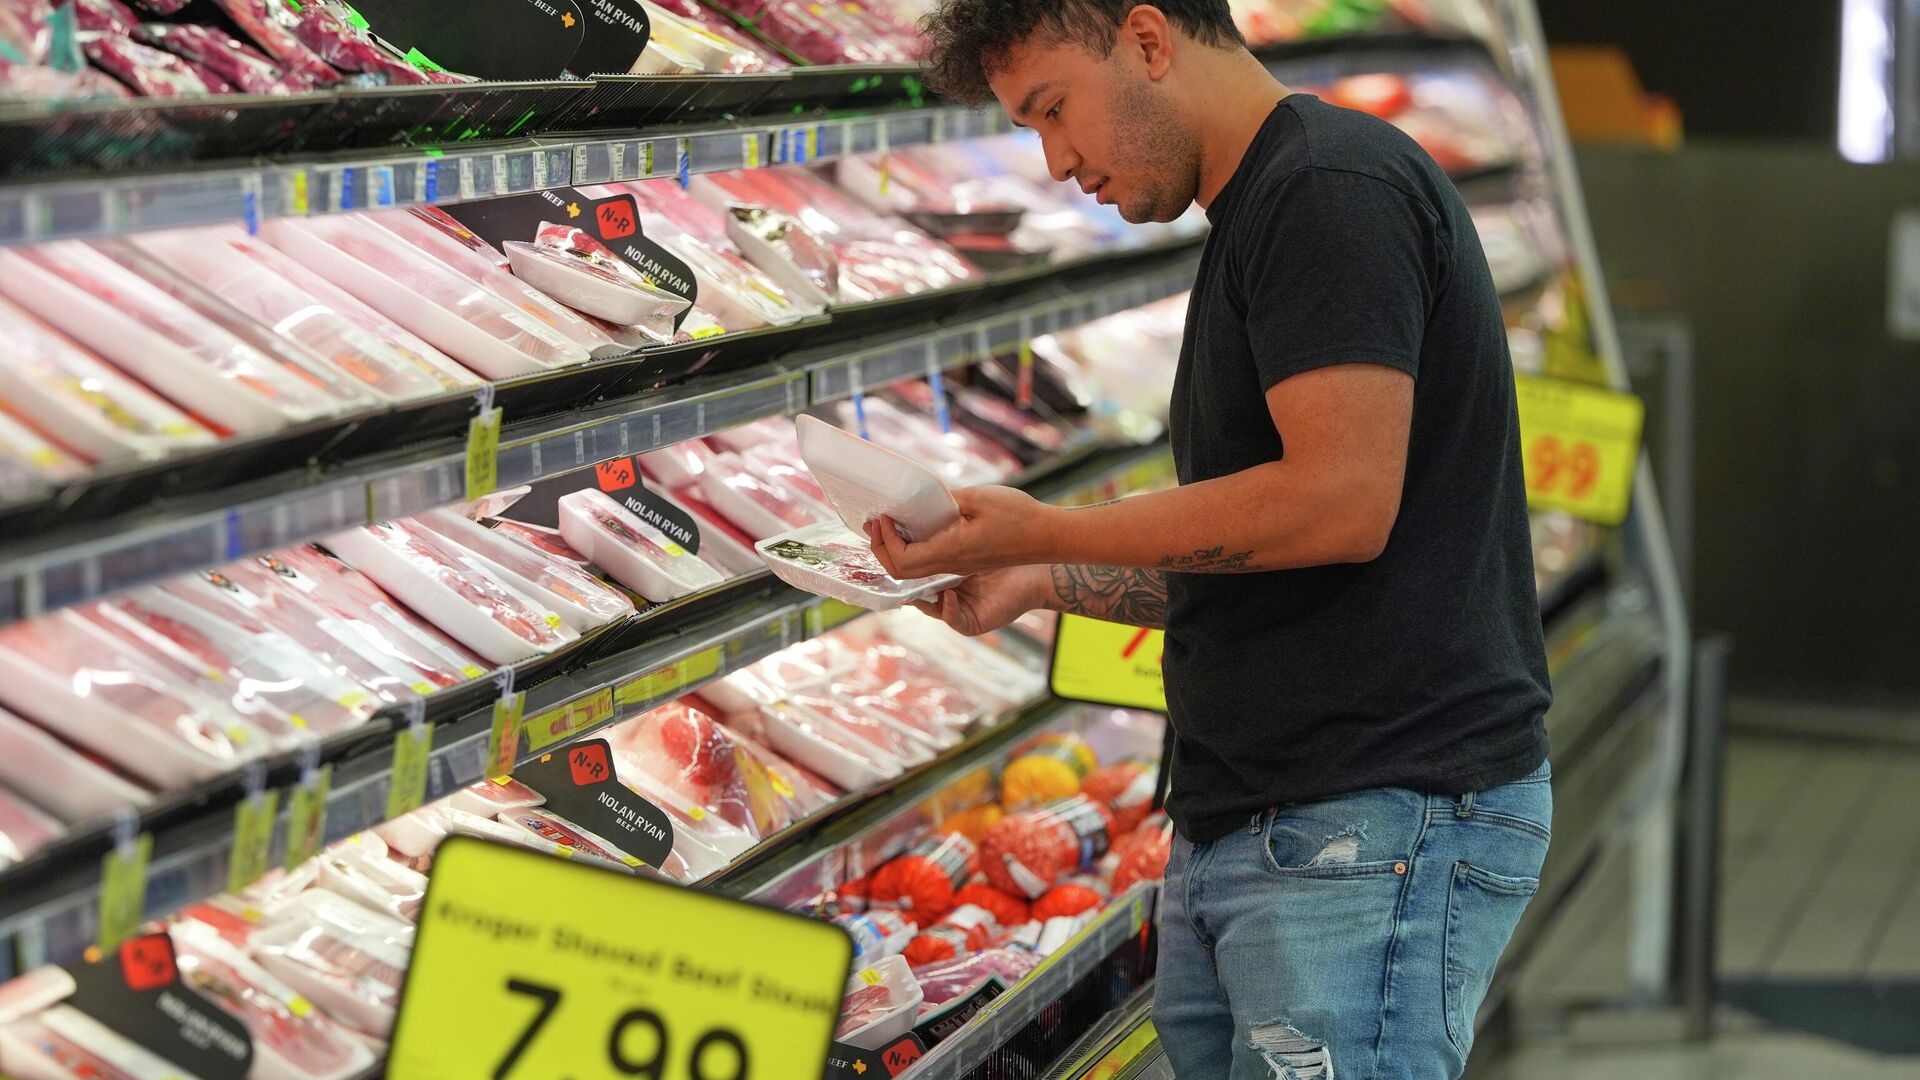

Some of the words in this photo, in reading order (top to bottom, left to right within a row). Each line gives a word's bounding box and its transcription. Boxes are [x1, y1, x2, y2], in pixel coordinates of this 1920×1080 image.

[534, 0, 559, 17] BEEF
[594, 9, 615, 25] BEEF
[612, 8, 644, 34] RYAN
[541, 190, 566, 207] BEEF
[624, 245, 663, 275] NOLAN
[660, 268, 691, 295] RYAN
[624, 496, 663, 526] NOLAN
[661, 519, 693, 544] RYAN
[597, 791, 637, 822] NOLAN
[634, 815, 666, 842] RYAN
[615, 817, 637, 833] BEEF
[671, 955, 741, 985] Beef
[829, 1057, 849, 1069] EEF
